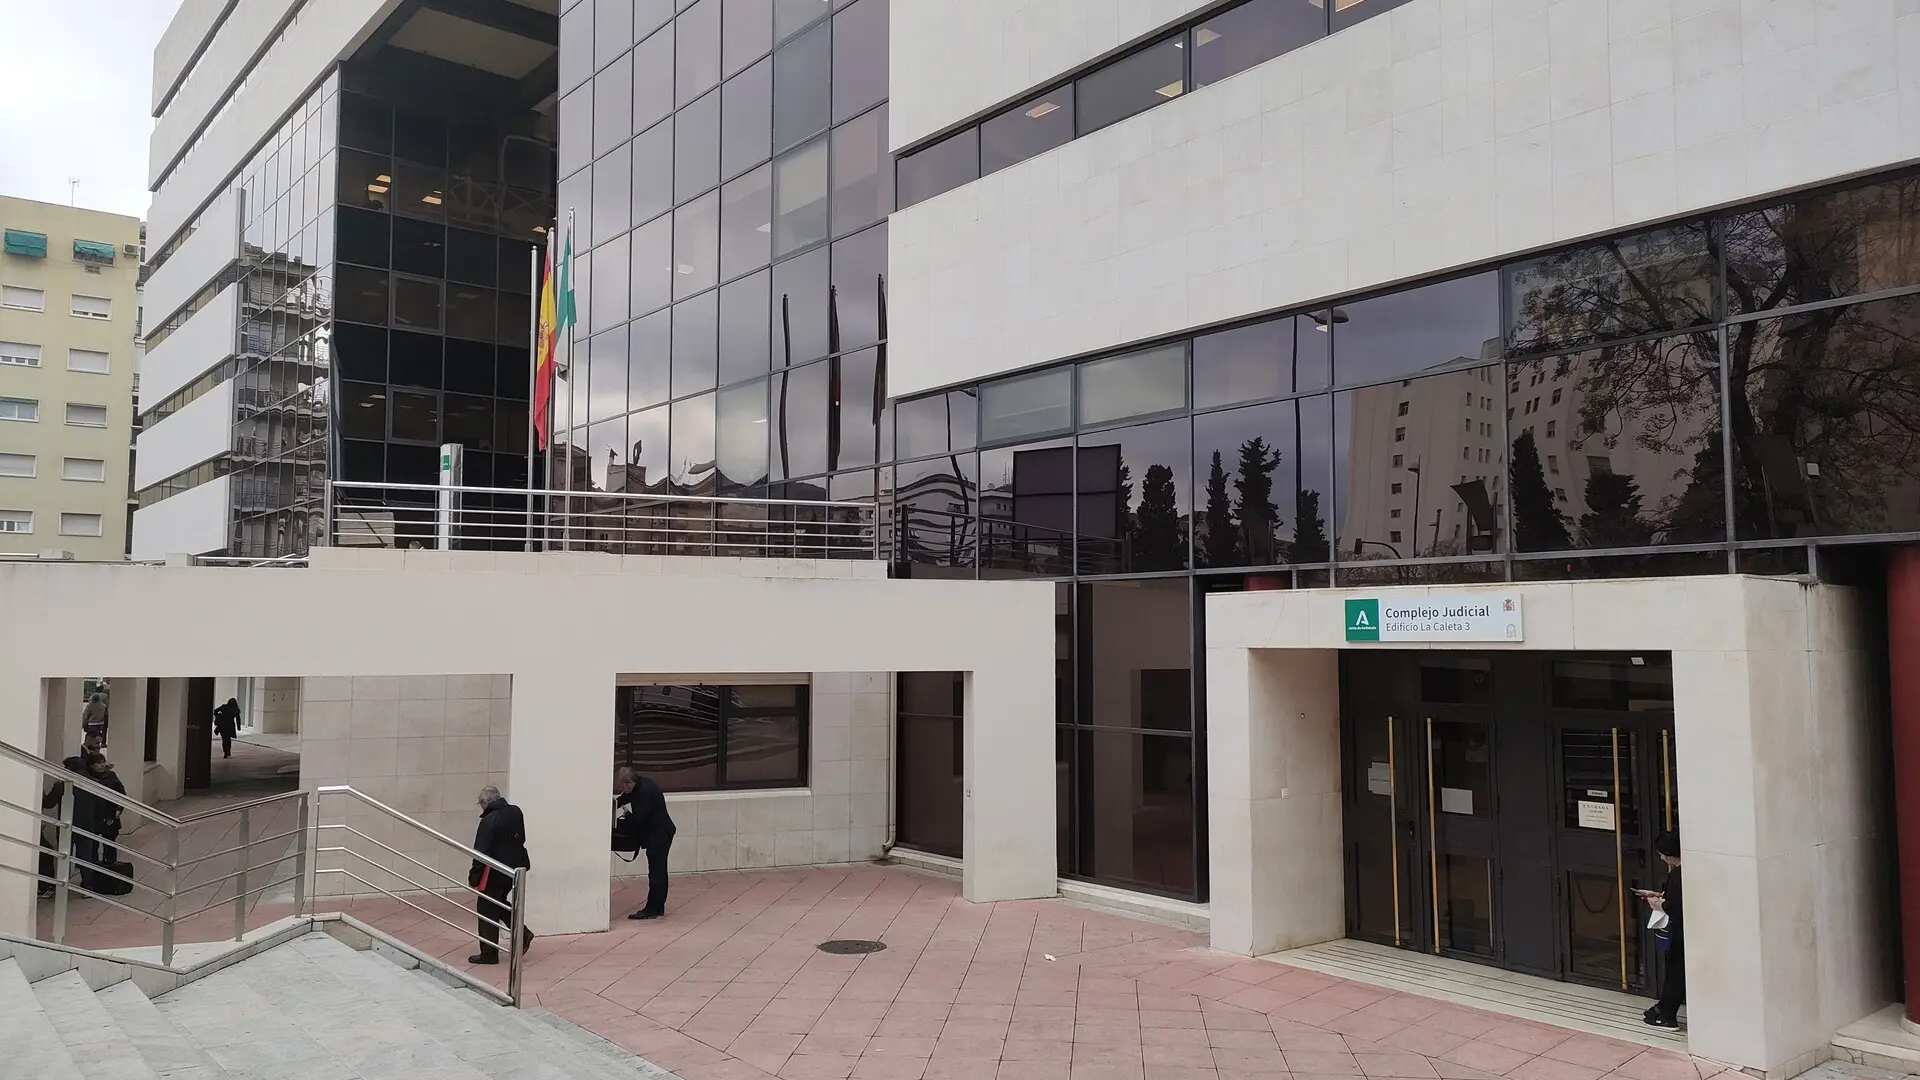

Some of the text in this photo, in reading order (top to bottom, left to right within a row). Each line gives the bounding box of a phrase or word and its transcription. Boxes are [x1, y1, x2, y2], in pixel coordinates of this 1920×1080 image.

[1385, 605, 1490, 620] Complejo Judicial
[1386, 621, 1471, 631] Edificio La Caleta 3
